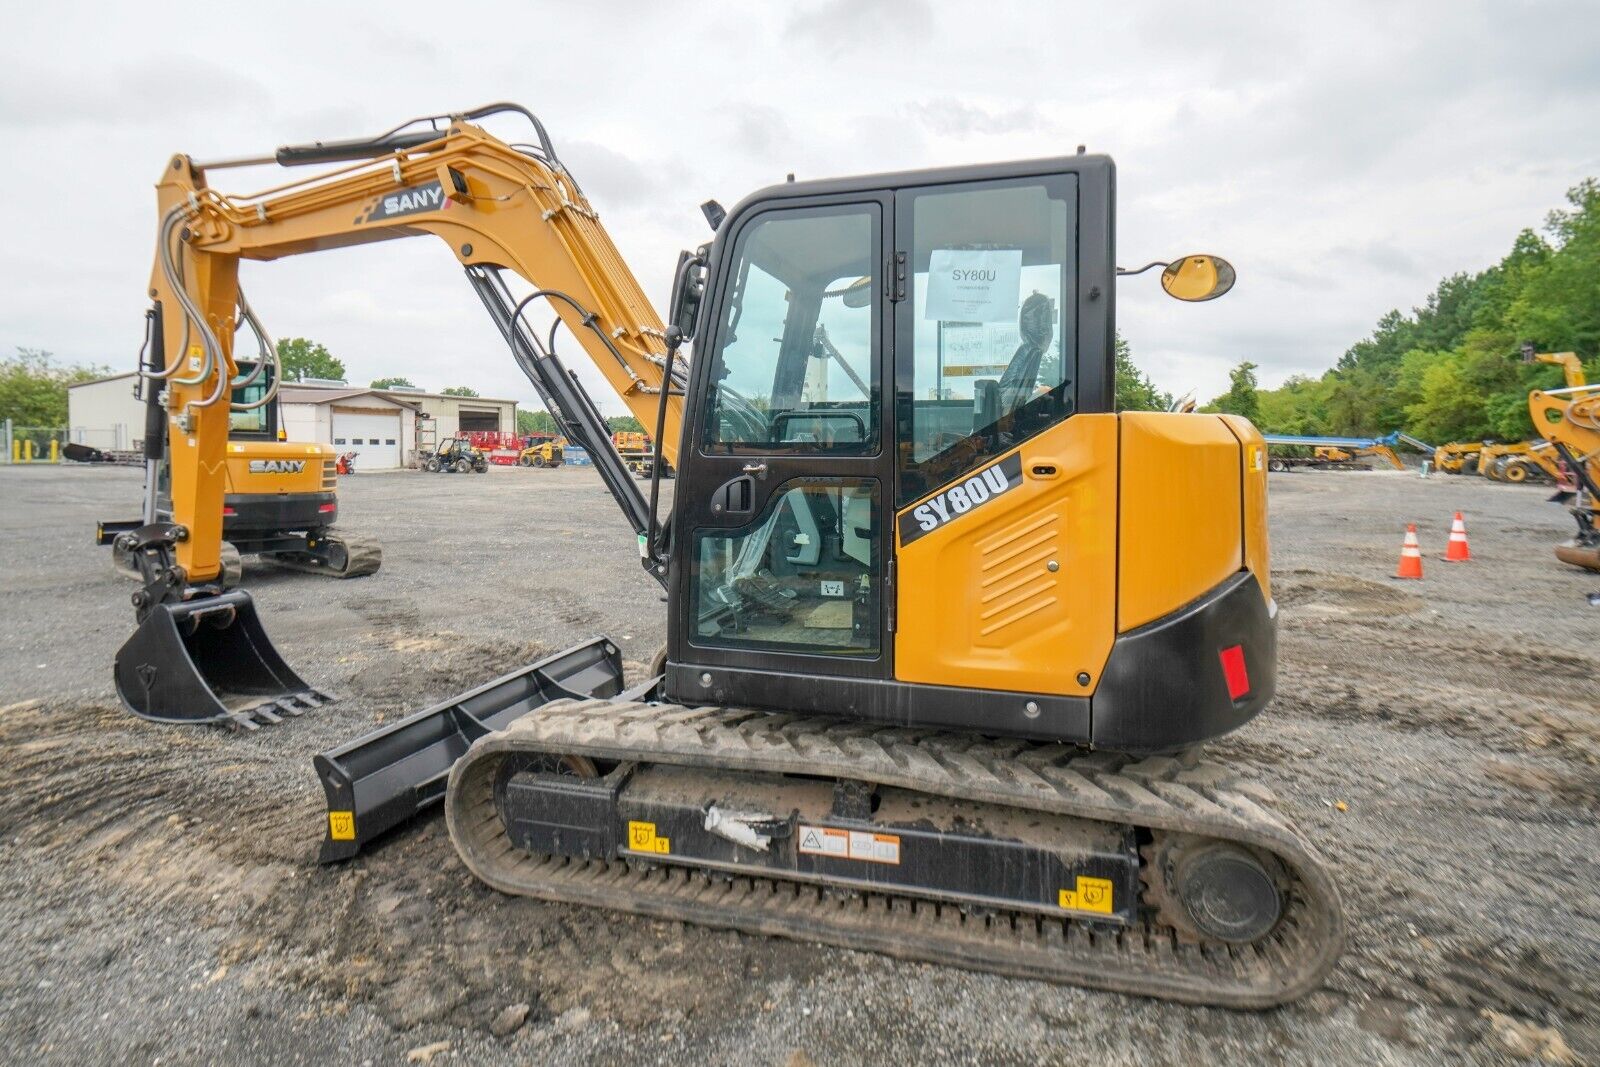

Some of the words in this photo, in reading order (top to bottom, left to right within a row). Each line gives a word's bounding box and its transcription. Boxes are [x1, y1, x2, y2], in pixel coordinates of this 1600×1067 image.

[384, 186, 442, 215] SANY
[952, 269, 996, 281] SY80U
[249, 460, 306, 473] SANY
[913, 464, 1009, 531] SY80U
